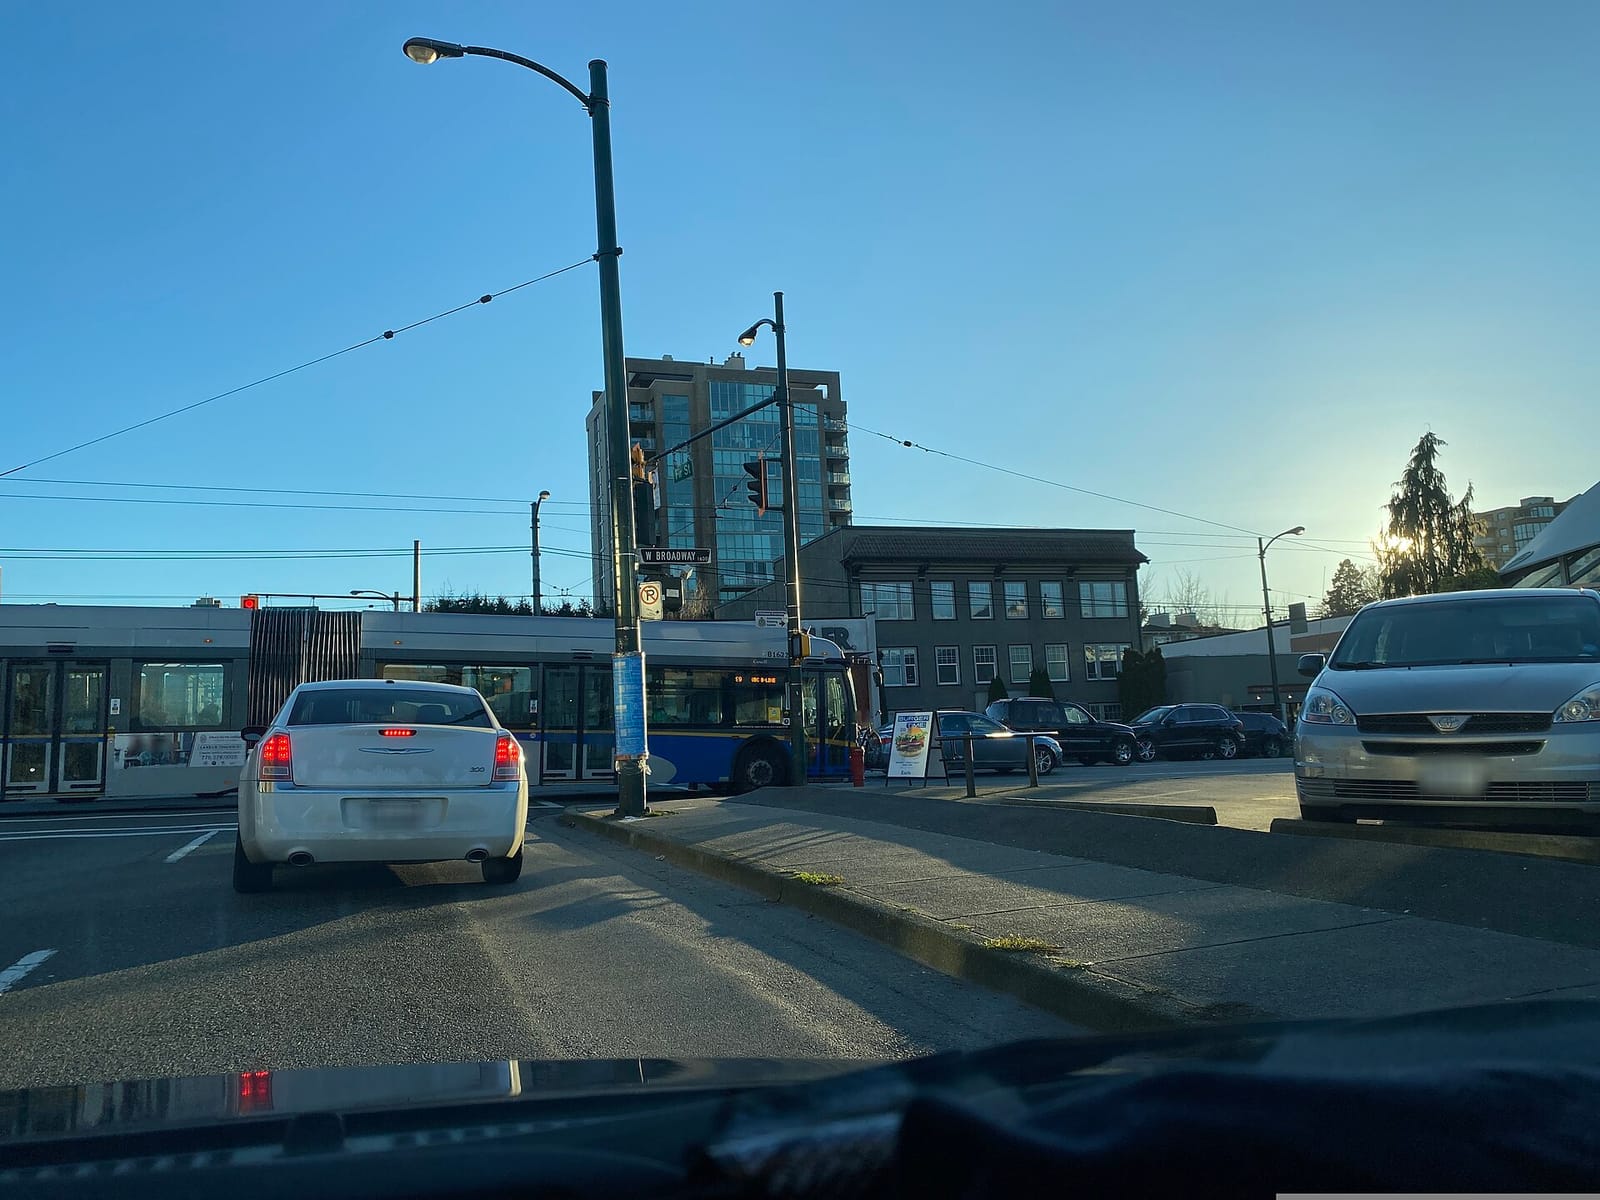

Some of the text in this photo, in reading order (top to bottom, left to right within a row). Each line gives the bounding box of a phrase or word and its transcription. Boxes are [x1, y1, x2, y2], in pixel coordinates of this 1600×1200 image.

[683, 464, 692, 476] St
[645, 551, 652, 561] W
[655, 551, 696, 561] BROADWAY
